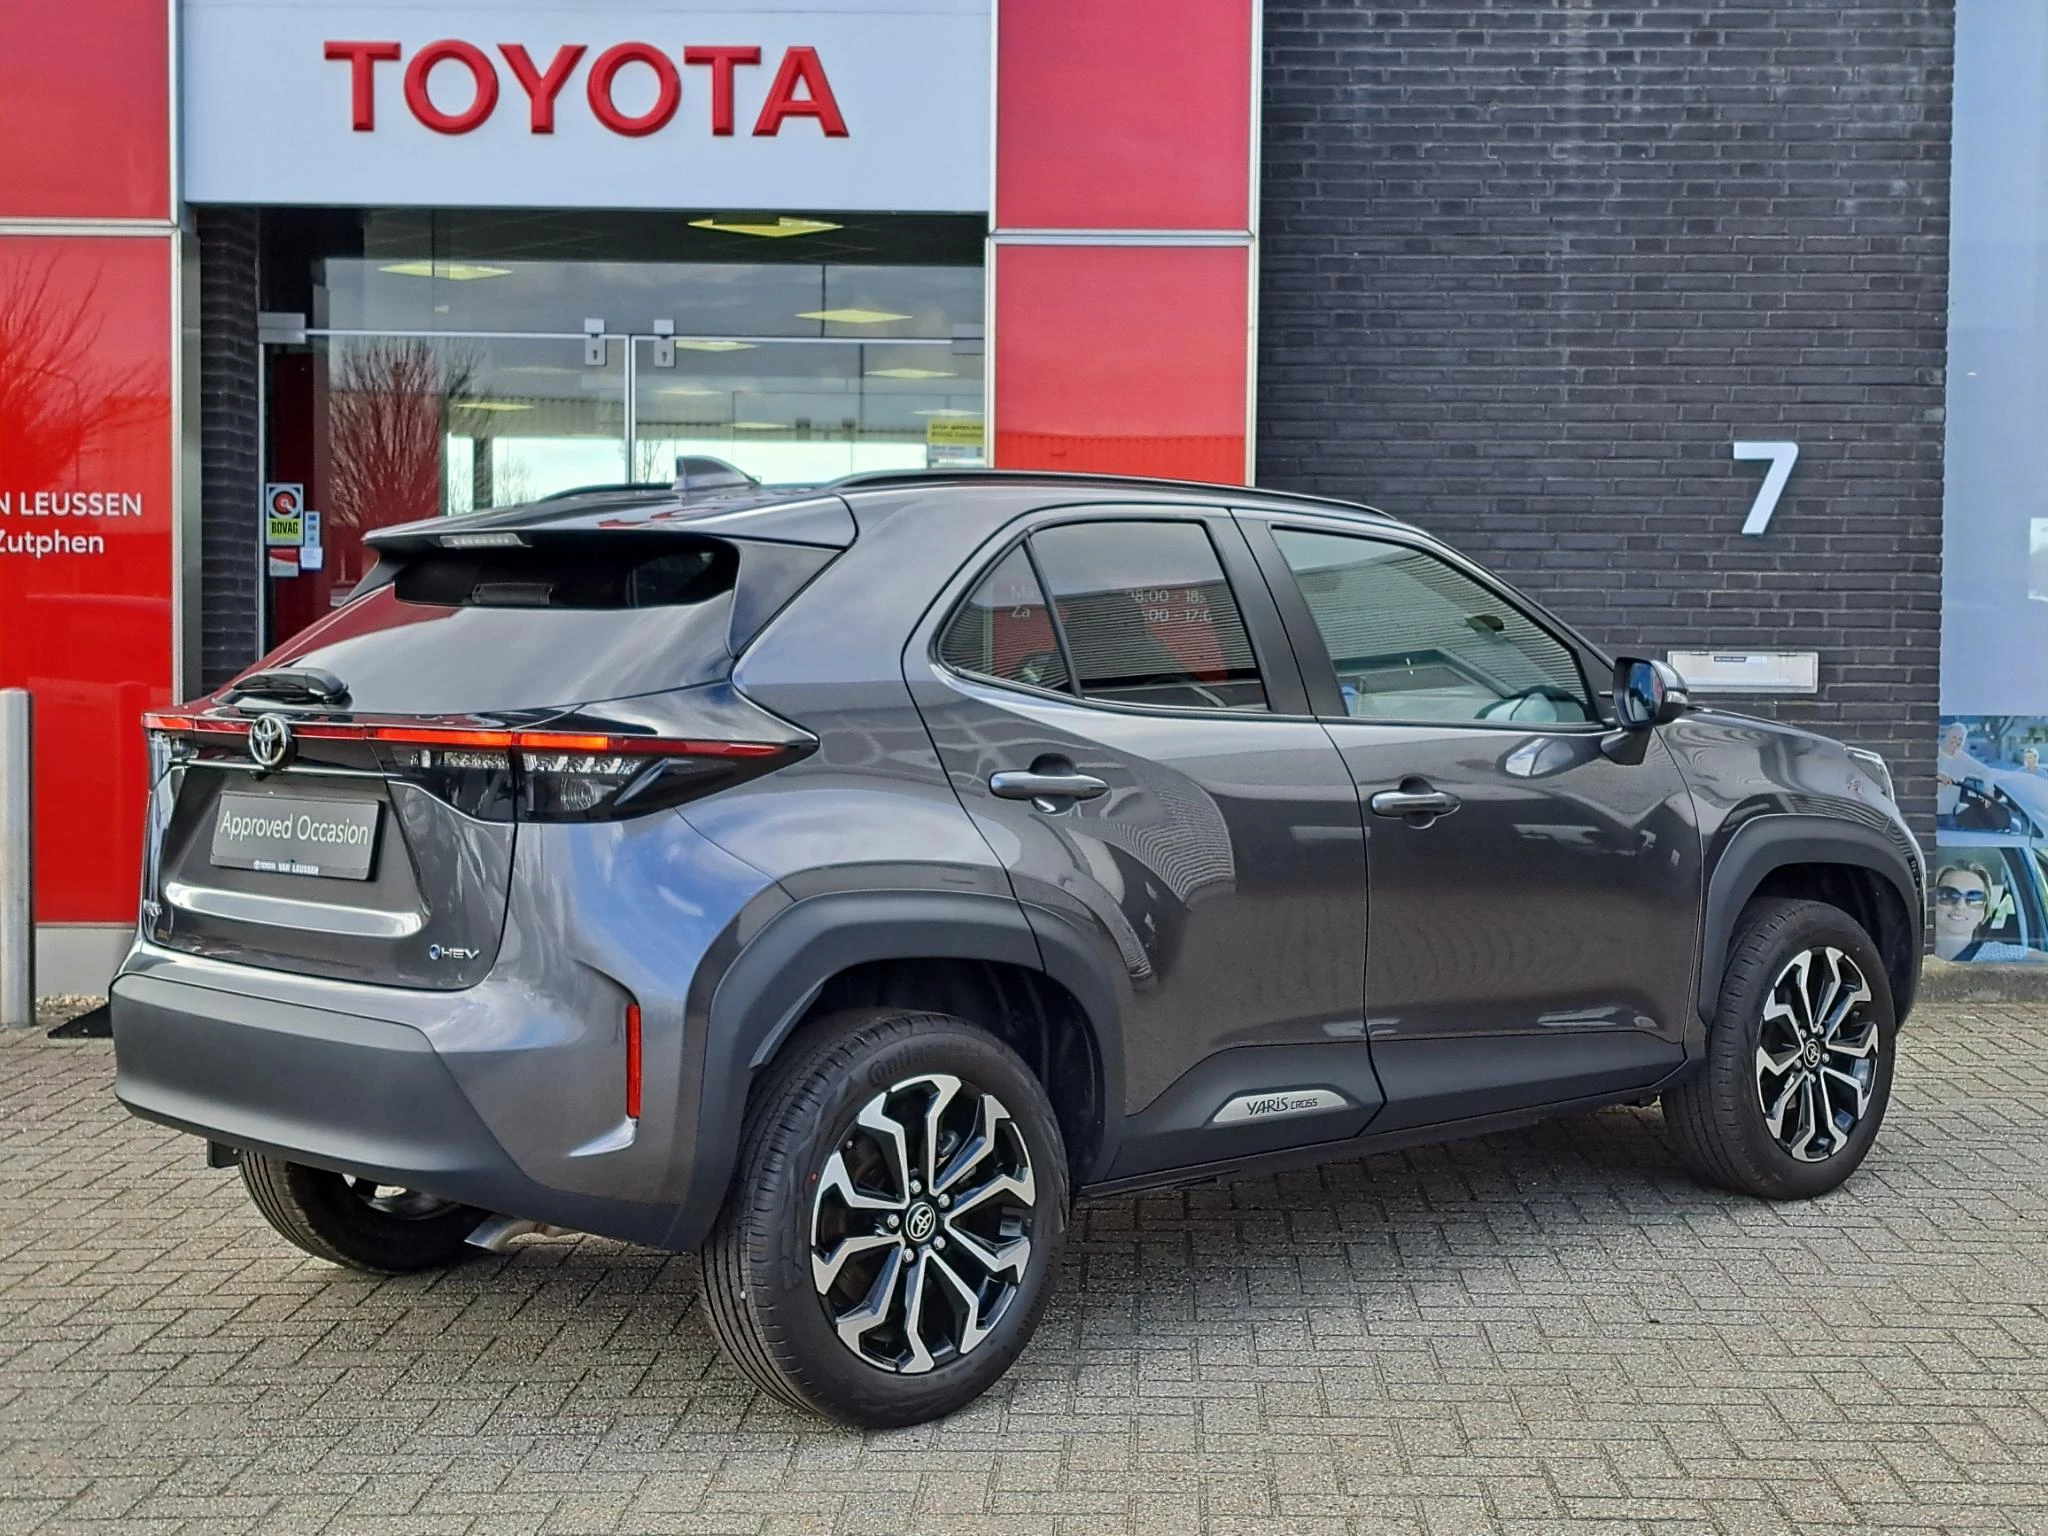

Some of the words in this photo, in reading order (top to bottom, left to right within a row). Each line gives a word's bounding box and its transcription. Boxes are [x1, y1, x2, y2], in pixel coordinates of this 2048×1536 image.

[324, 38, 849, 137] TOYOTA
[1733, 441, 1799, 534] 7
[20, 491, 142, 516] LEUSSEN
[271, 521, 298, 535] BOVAG
[219, 810, 293, 842] Approved
[297, 815, 369, 845] Occasion
[278, 862, 291, 872] VAN
[441, 947, 480, 960] HEV
[1290, 1098, 1318, 1110] CROSS
